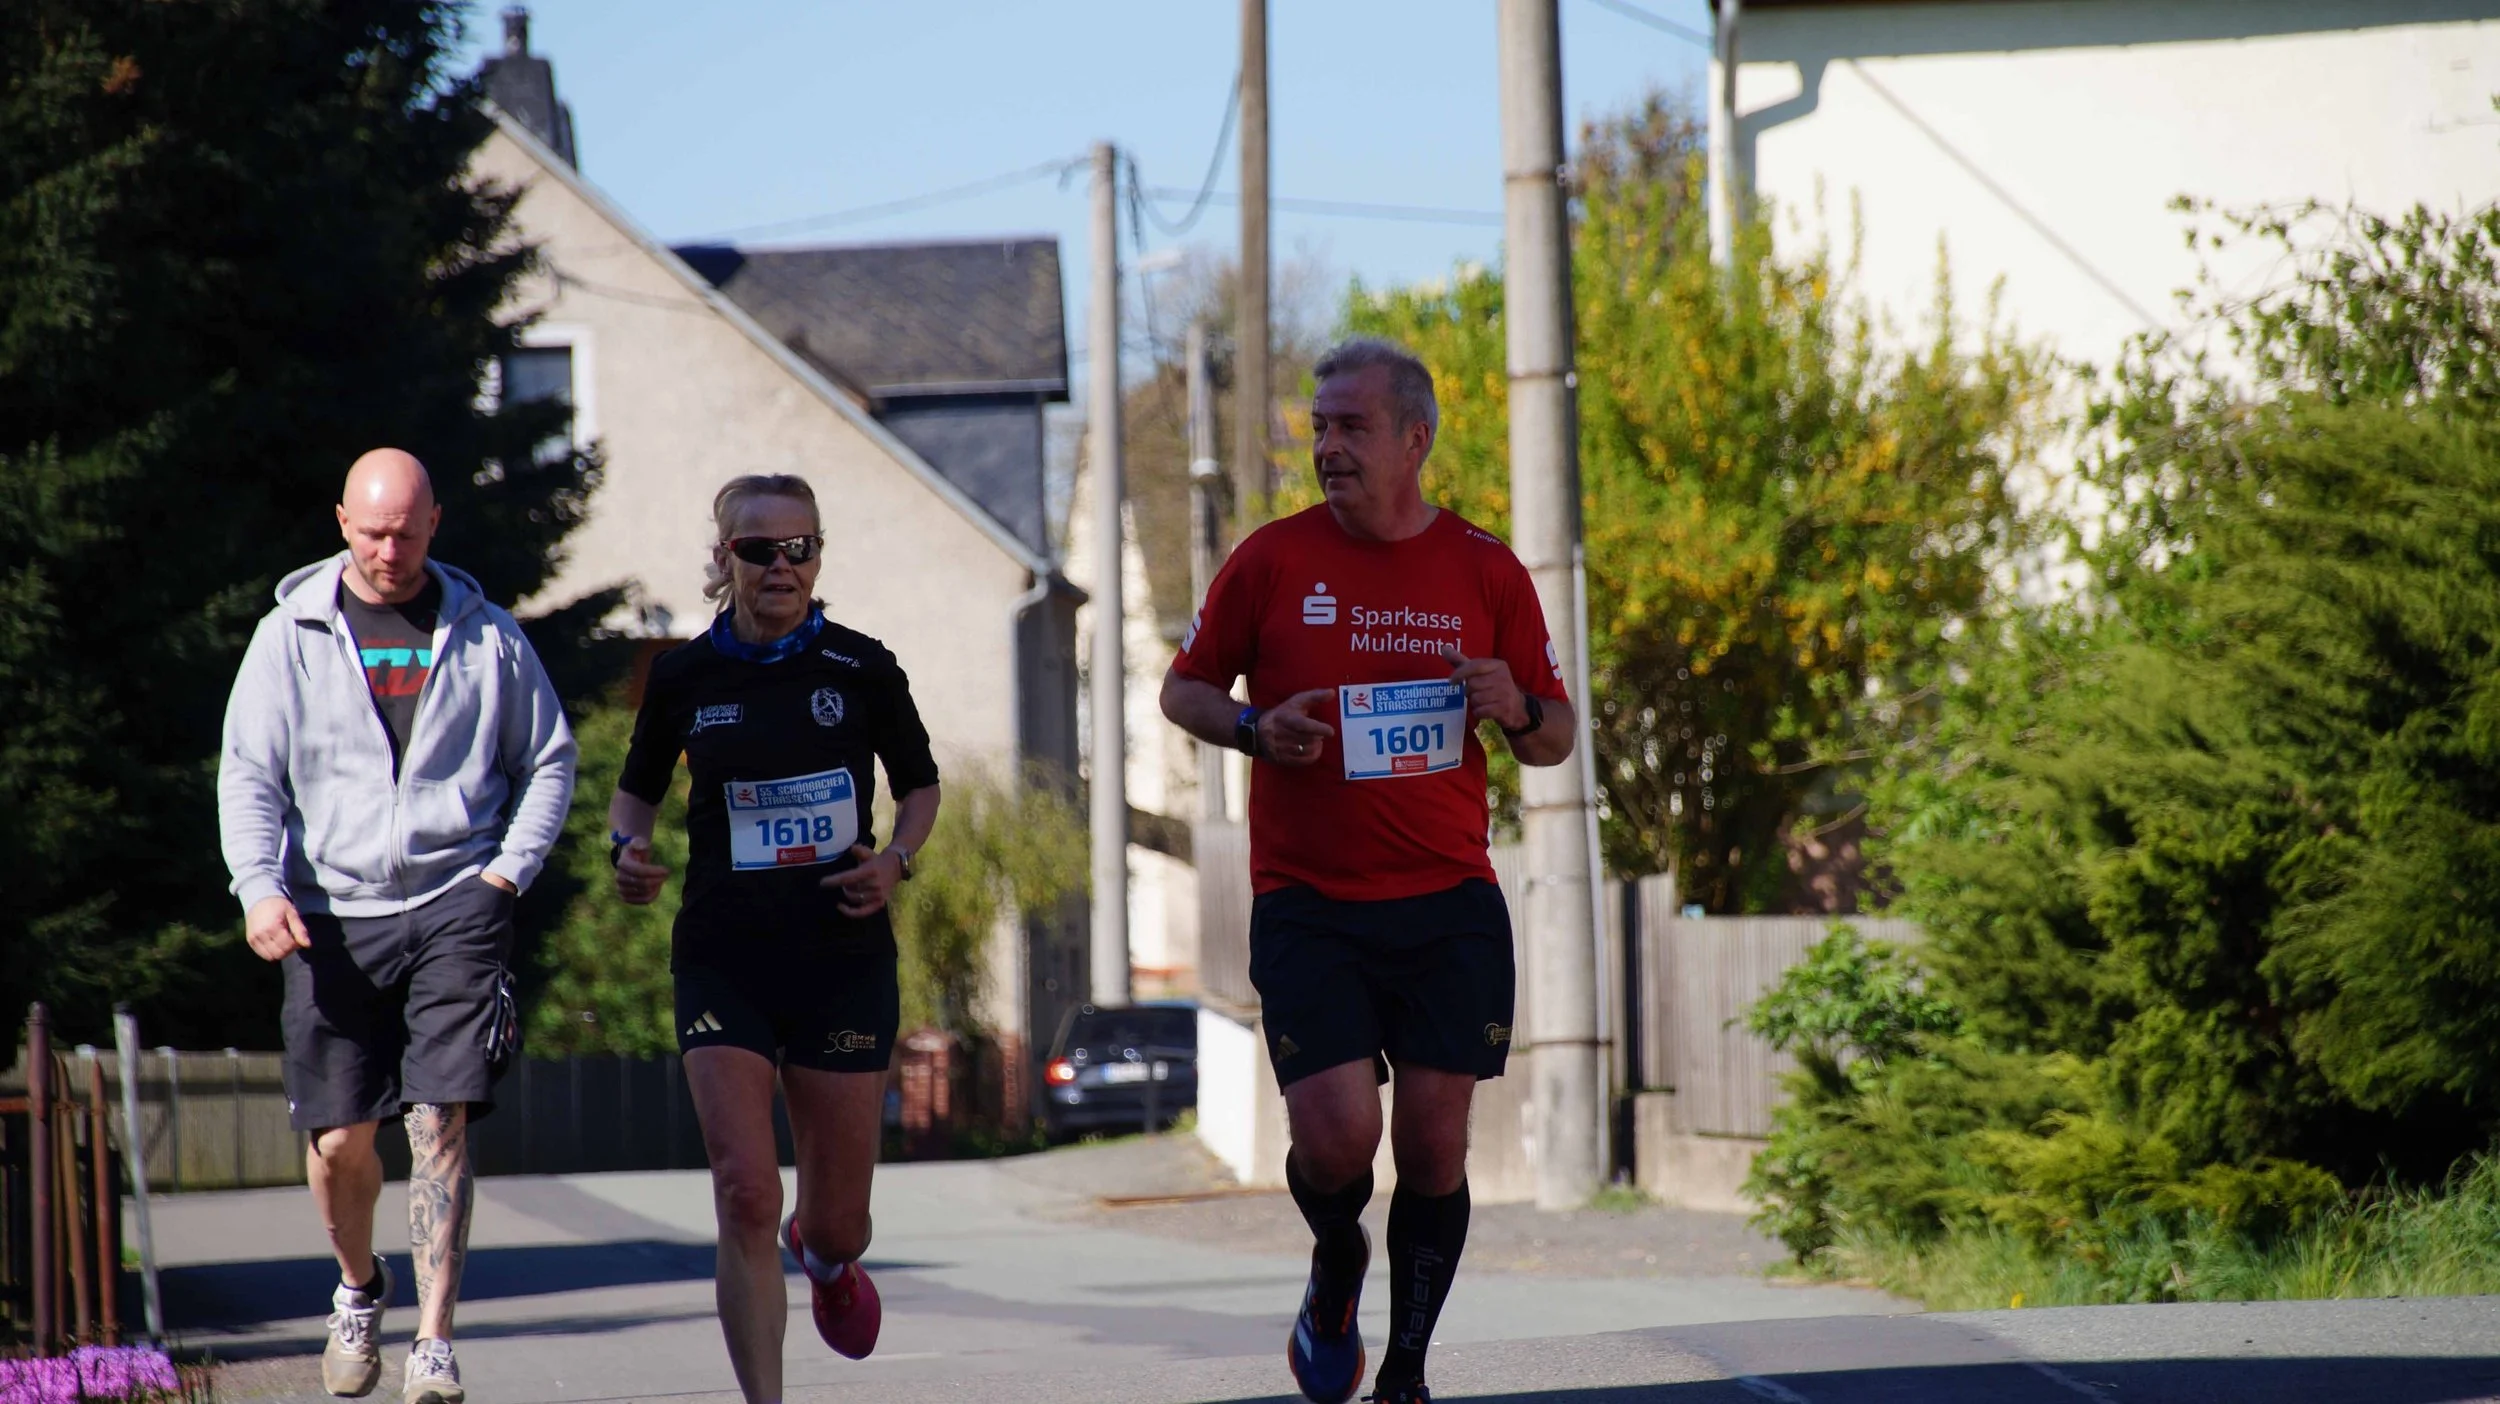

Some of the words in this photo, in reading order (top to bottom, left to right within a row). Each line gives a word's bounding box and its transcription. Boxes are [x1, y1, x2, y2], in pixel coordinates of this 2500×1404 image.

[1350, 605, 1462, 630] Sparkasse
[821, 649, 854, 664] CRAFT
[1376, 691, 1392, 702] 55.
[1394, 684, 1460, 699] SCHÖNBACHER
[1377, 697, 1447, 712] STRASSENLAUF
[1368, 723, 1444, 756] 1601
[759, 787, 775, 797] 55.
[777, 776, 845, 794] SCHÖNBACHER
[761, 789, 832, 807] STRASSENLAUF
[755, 815, 833, 847] 1618
